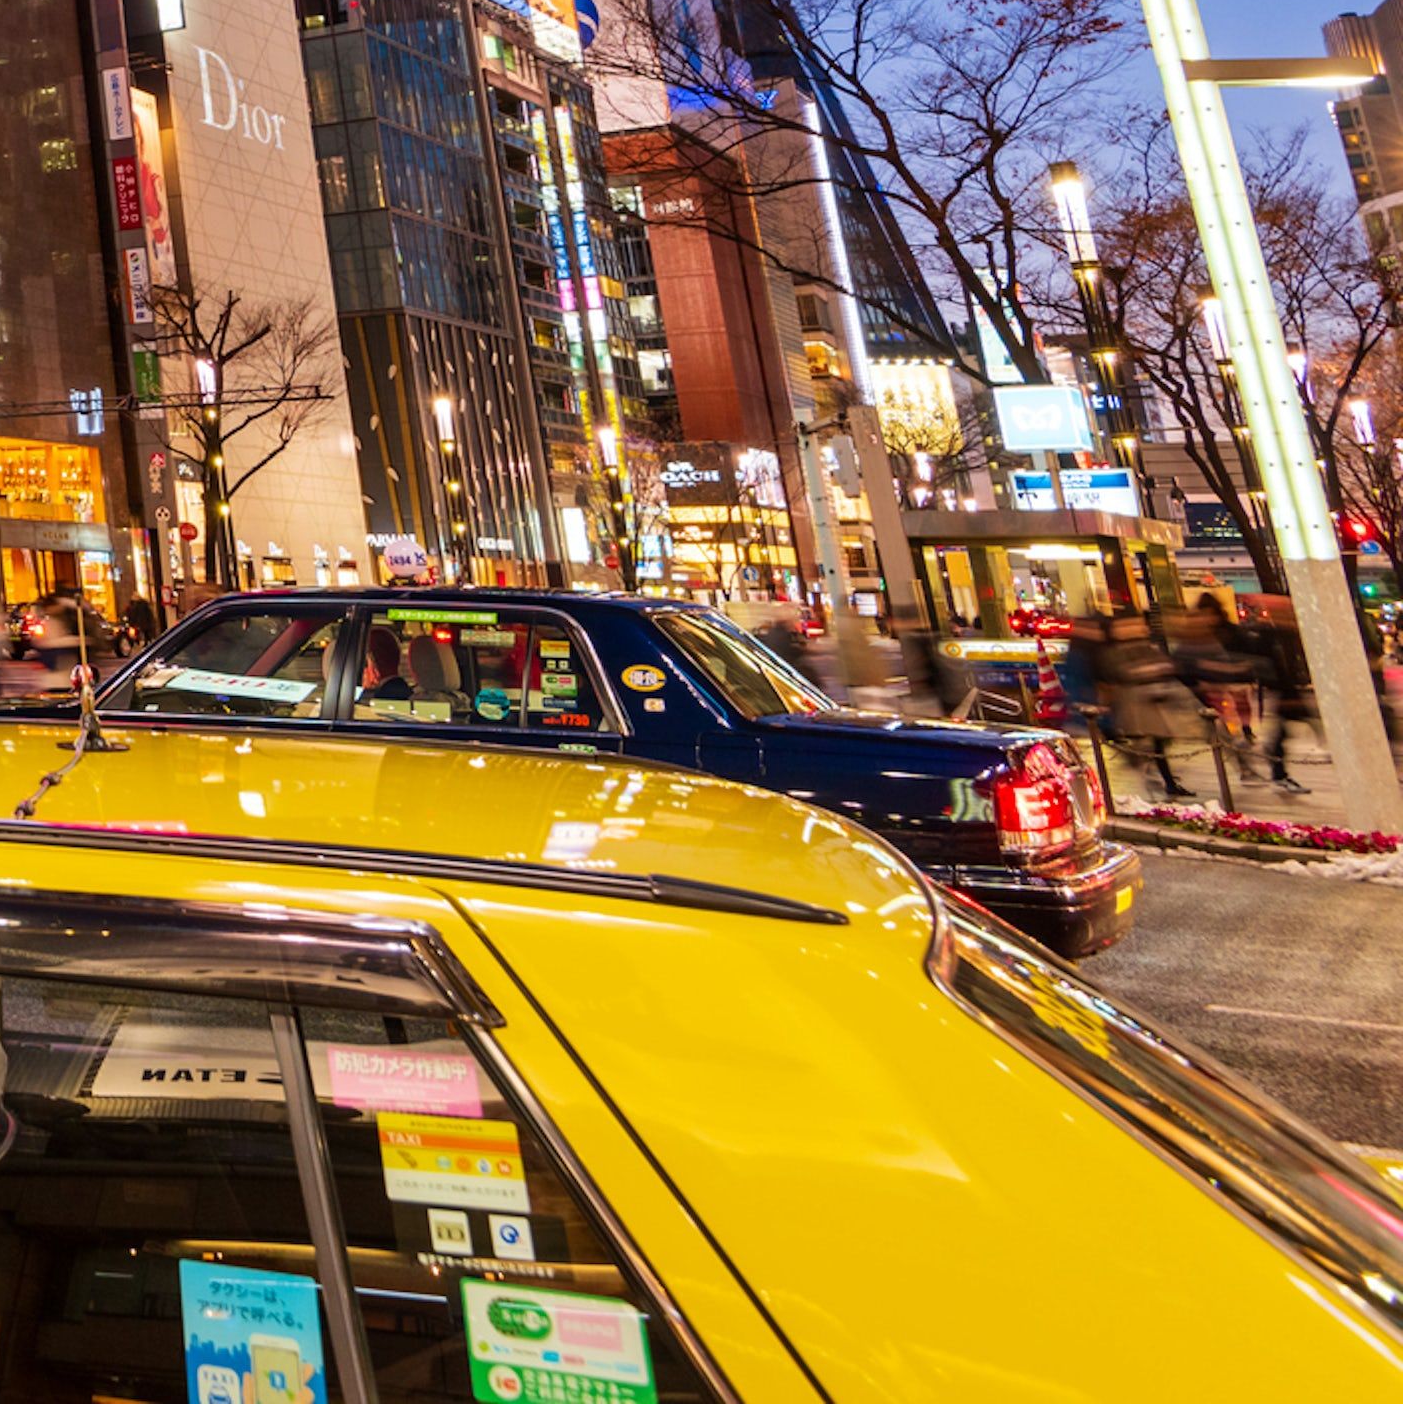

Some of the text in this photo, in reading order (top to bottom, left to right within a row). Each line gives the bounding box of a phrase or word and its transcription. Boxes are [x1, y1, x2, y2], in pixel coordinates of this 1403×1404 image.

[193, 45, 287, 152] Dior
[335, 1050, 468, 1083] 防犯カメラ作動中
[386, 1131, 422, 1146] TAXI
[209, 1280, 287, 1306] タクシーは、
[201, 1370, 236, 1385] TAXI
